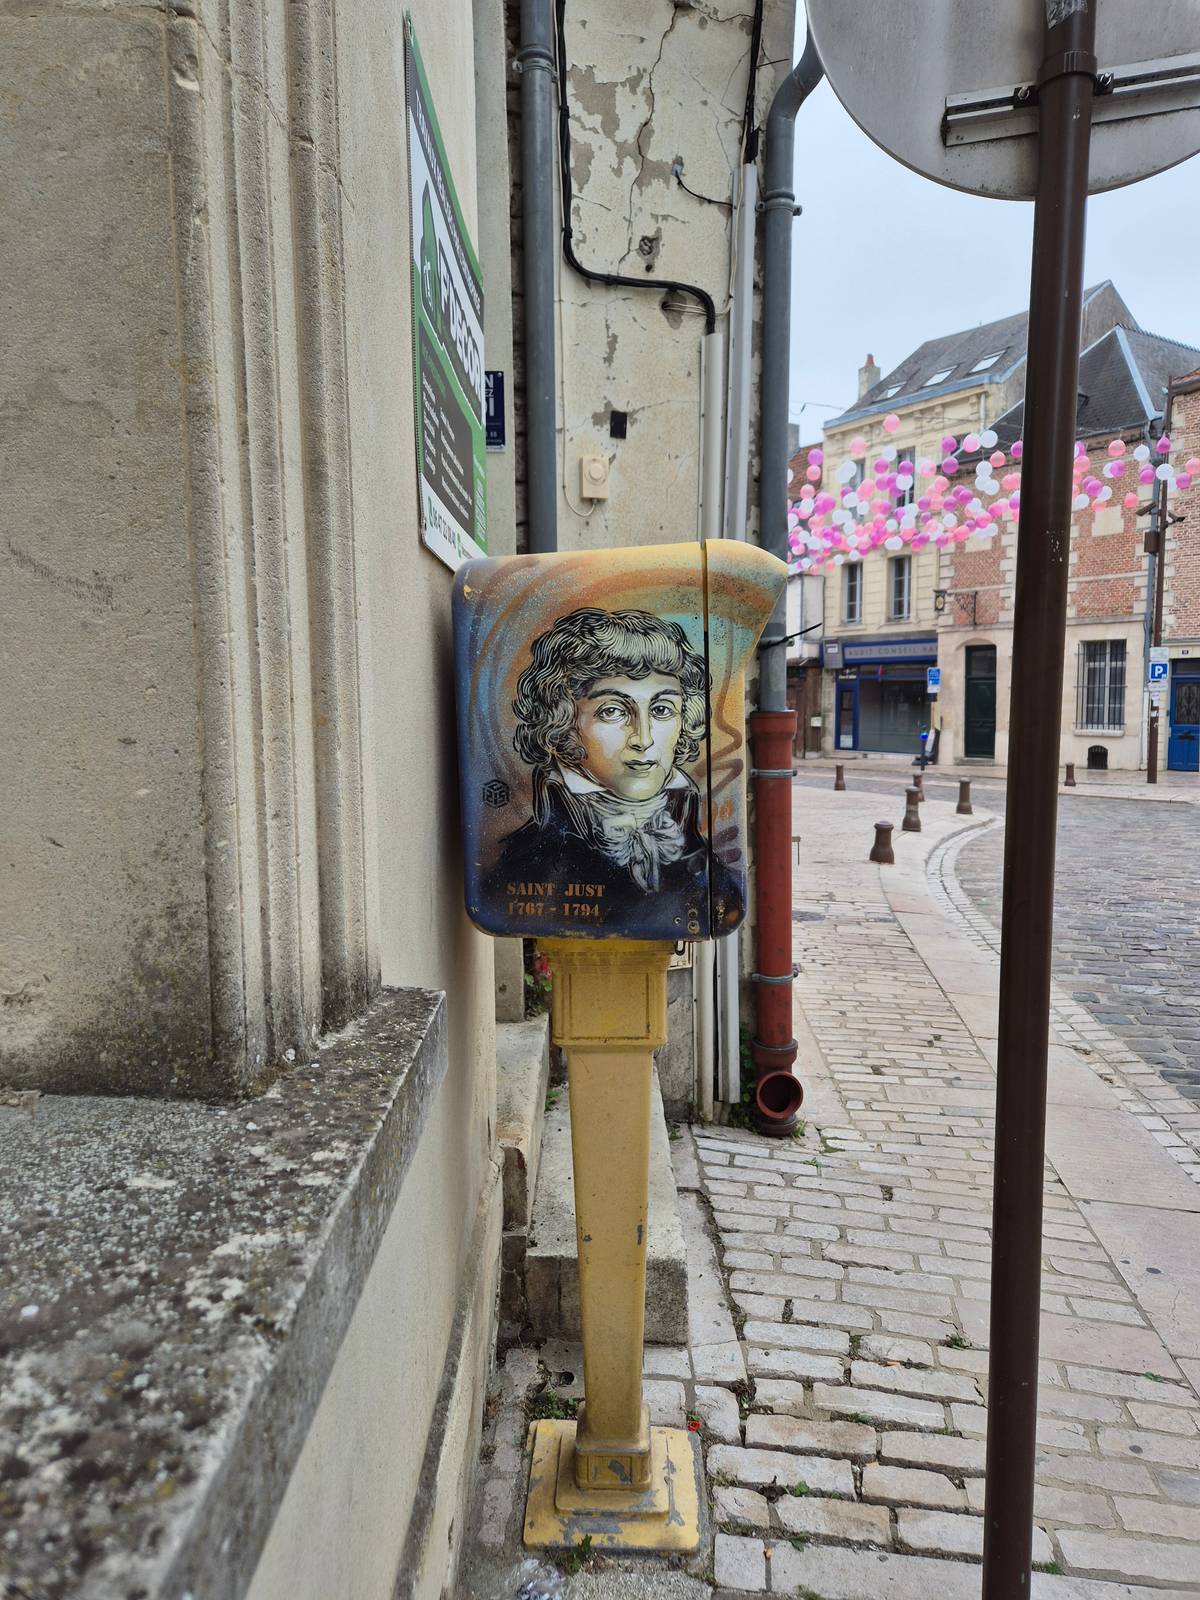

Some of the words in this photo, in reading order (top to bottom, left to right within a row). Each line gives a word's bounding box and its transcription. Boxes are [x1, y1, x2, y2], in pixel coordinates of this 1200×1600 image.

[879, 646, 916, 655] CONSEIL
[1155, 666, 1163, 677] P
[507, 882, 555, 896] SAINT
[565, 883, 605, 897] JUST
[508, 902, 544, 916] 1767
[563, 903, 599, 916] 1794
